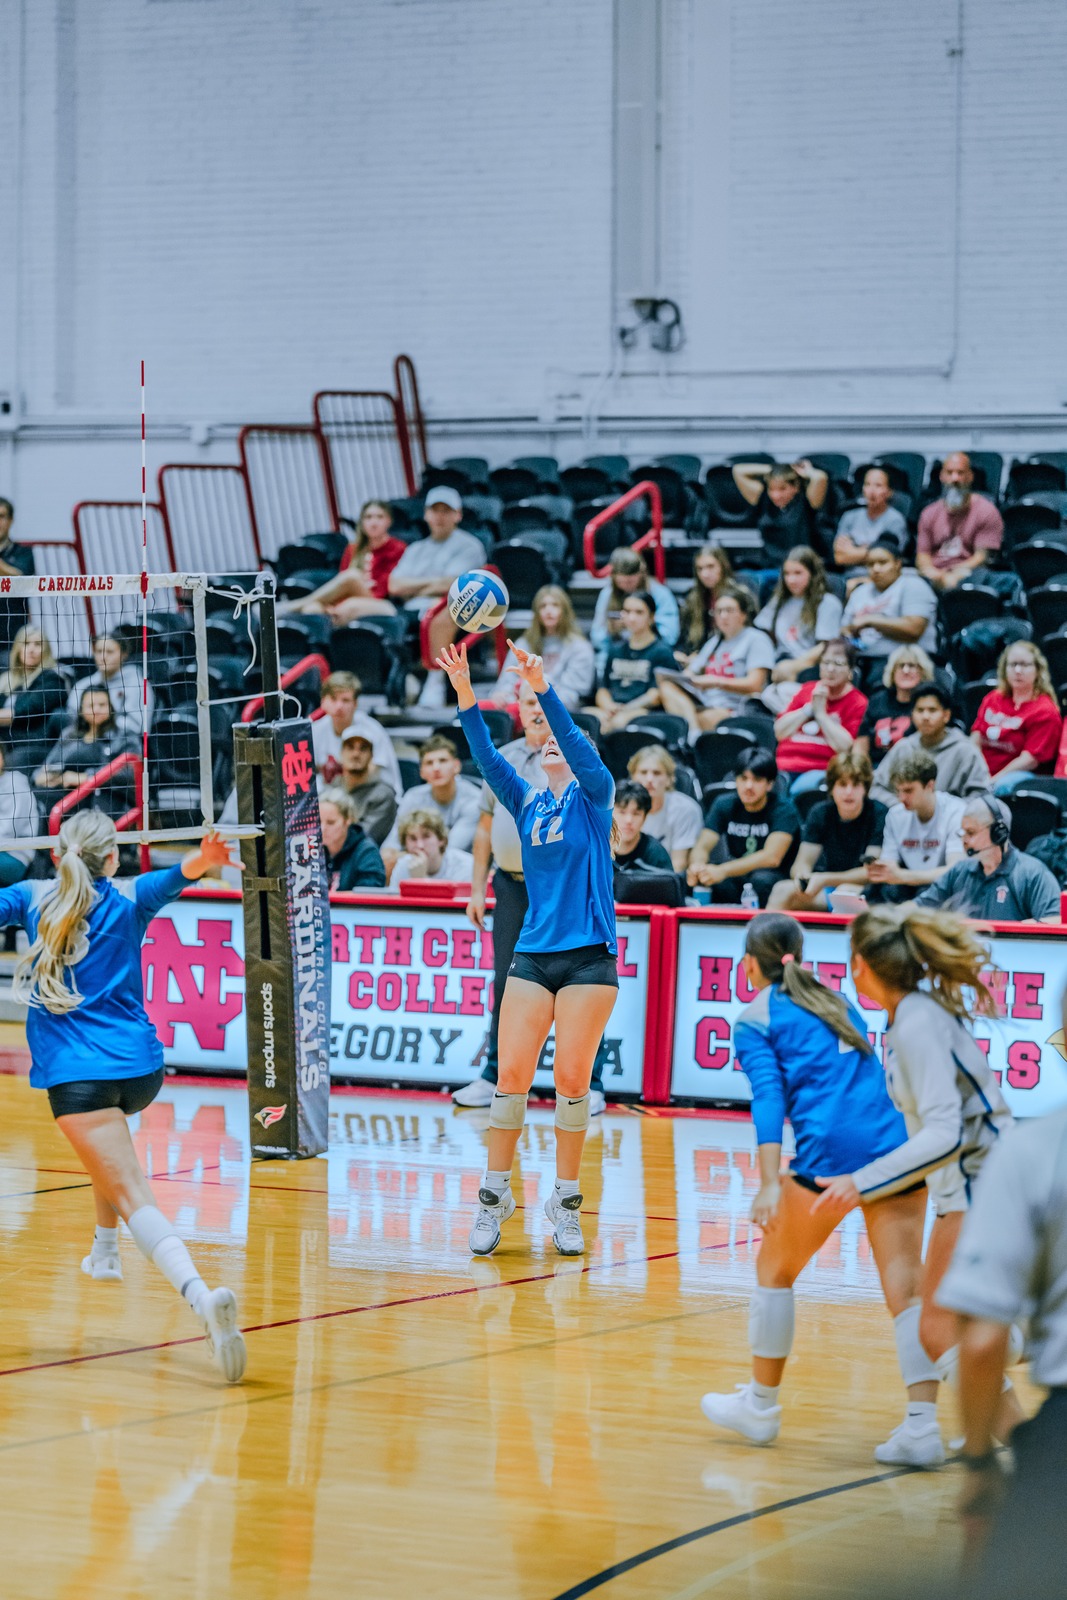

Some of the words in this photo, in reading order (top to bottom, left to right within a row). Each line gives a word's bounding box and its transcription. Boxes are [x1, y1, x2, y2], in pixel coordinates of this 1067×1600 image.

[38, 576, 113, 591] CARDINALS
[451, 588, 474, 616] molten
[460, 595, 481, 622] NCAA
[531, 815, 564, 846] 12
[308, 835, 324, 899] NORTH
[290, 834, 319, 1092] CARDINALS
[313, 905, 325, 991] CENTRAL
[332, 923, 412, 966] RTH
[259, 982, 275, 1030] sports
[348, 970, 495, 1016] COLLE
[261, 1031, 276, 1089] imports
[316, 1000, 328, 1085] COLLEGE
